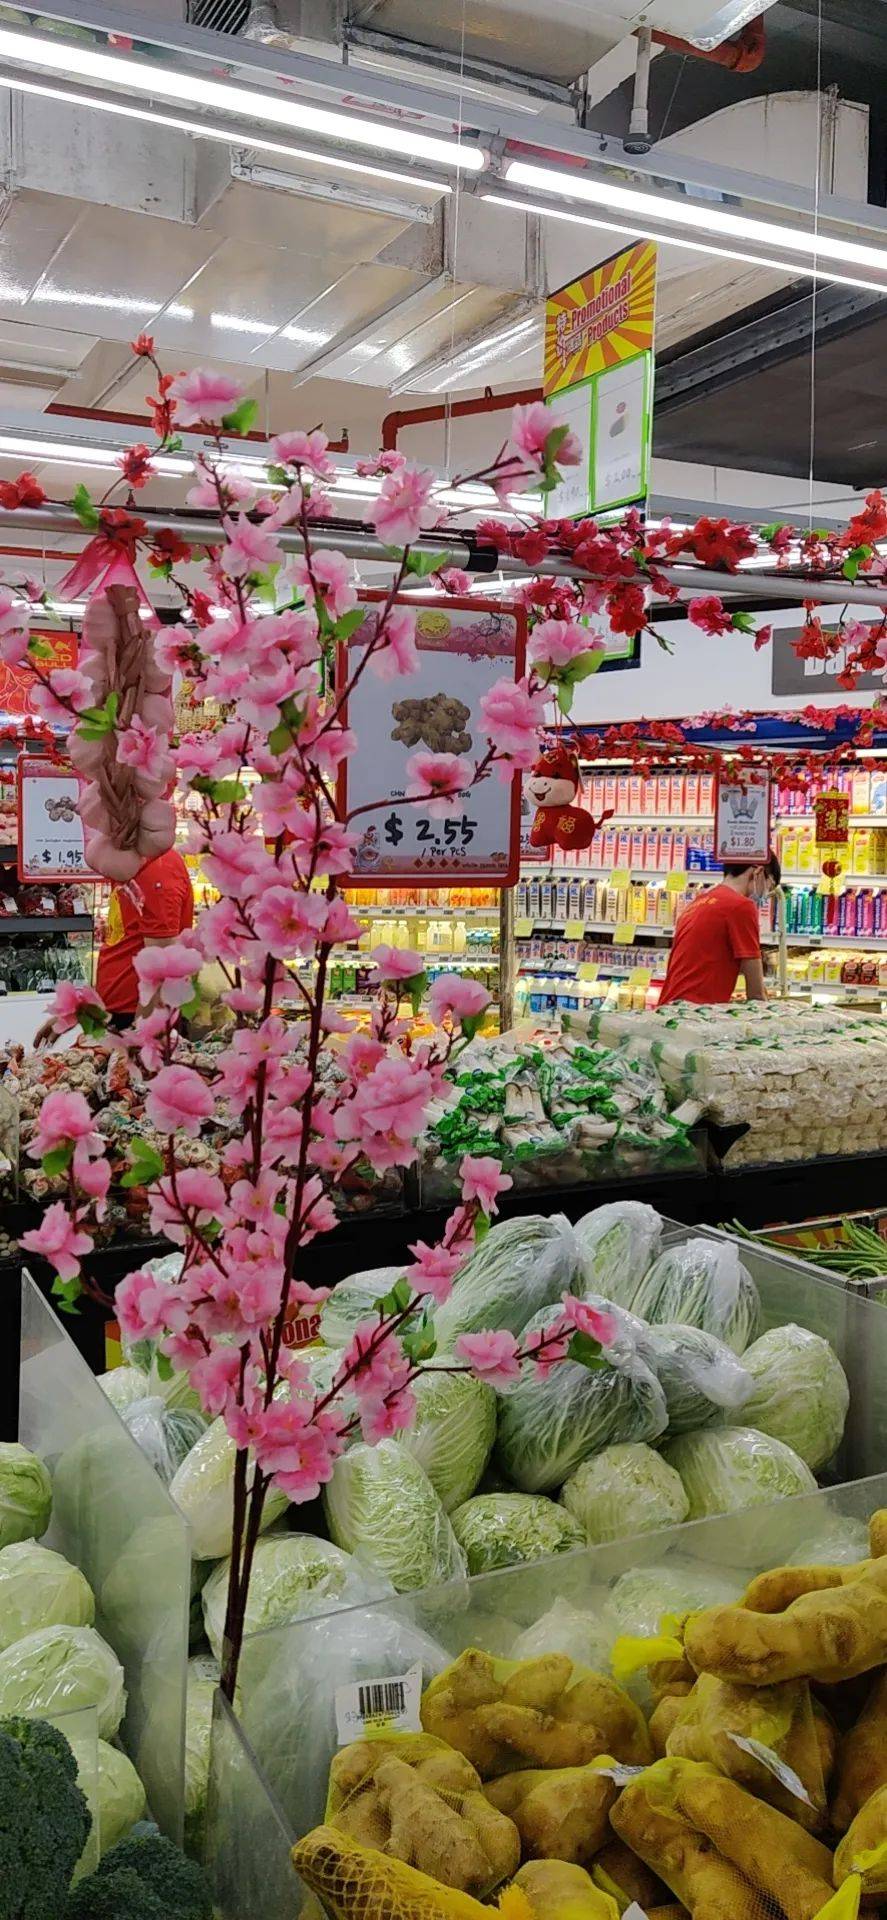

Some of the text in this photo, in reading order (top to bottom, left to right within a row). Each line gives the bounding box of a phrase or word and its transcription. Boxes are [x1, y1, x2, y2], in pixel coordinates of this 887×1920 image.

[571, 271, 631, 331] Promotional
[587, 302, 628, 344] Products
[385, 812, 478, 846] $ 2.55
[42, 849, 83, 864] $ 1.95
[430, 847, 447, 857] Per
